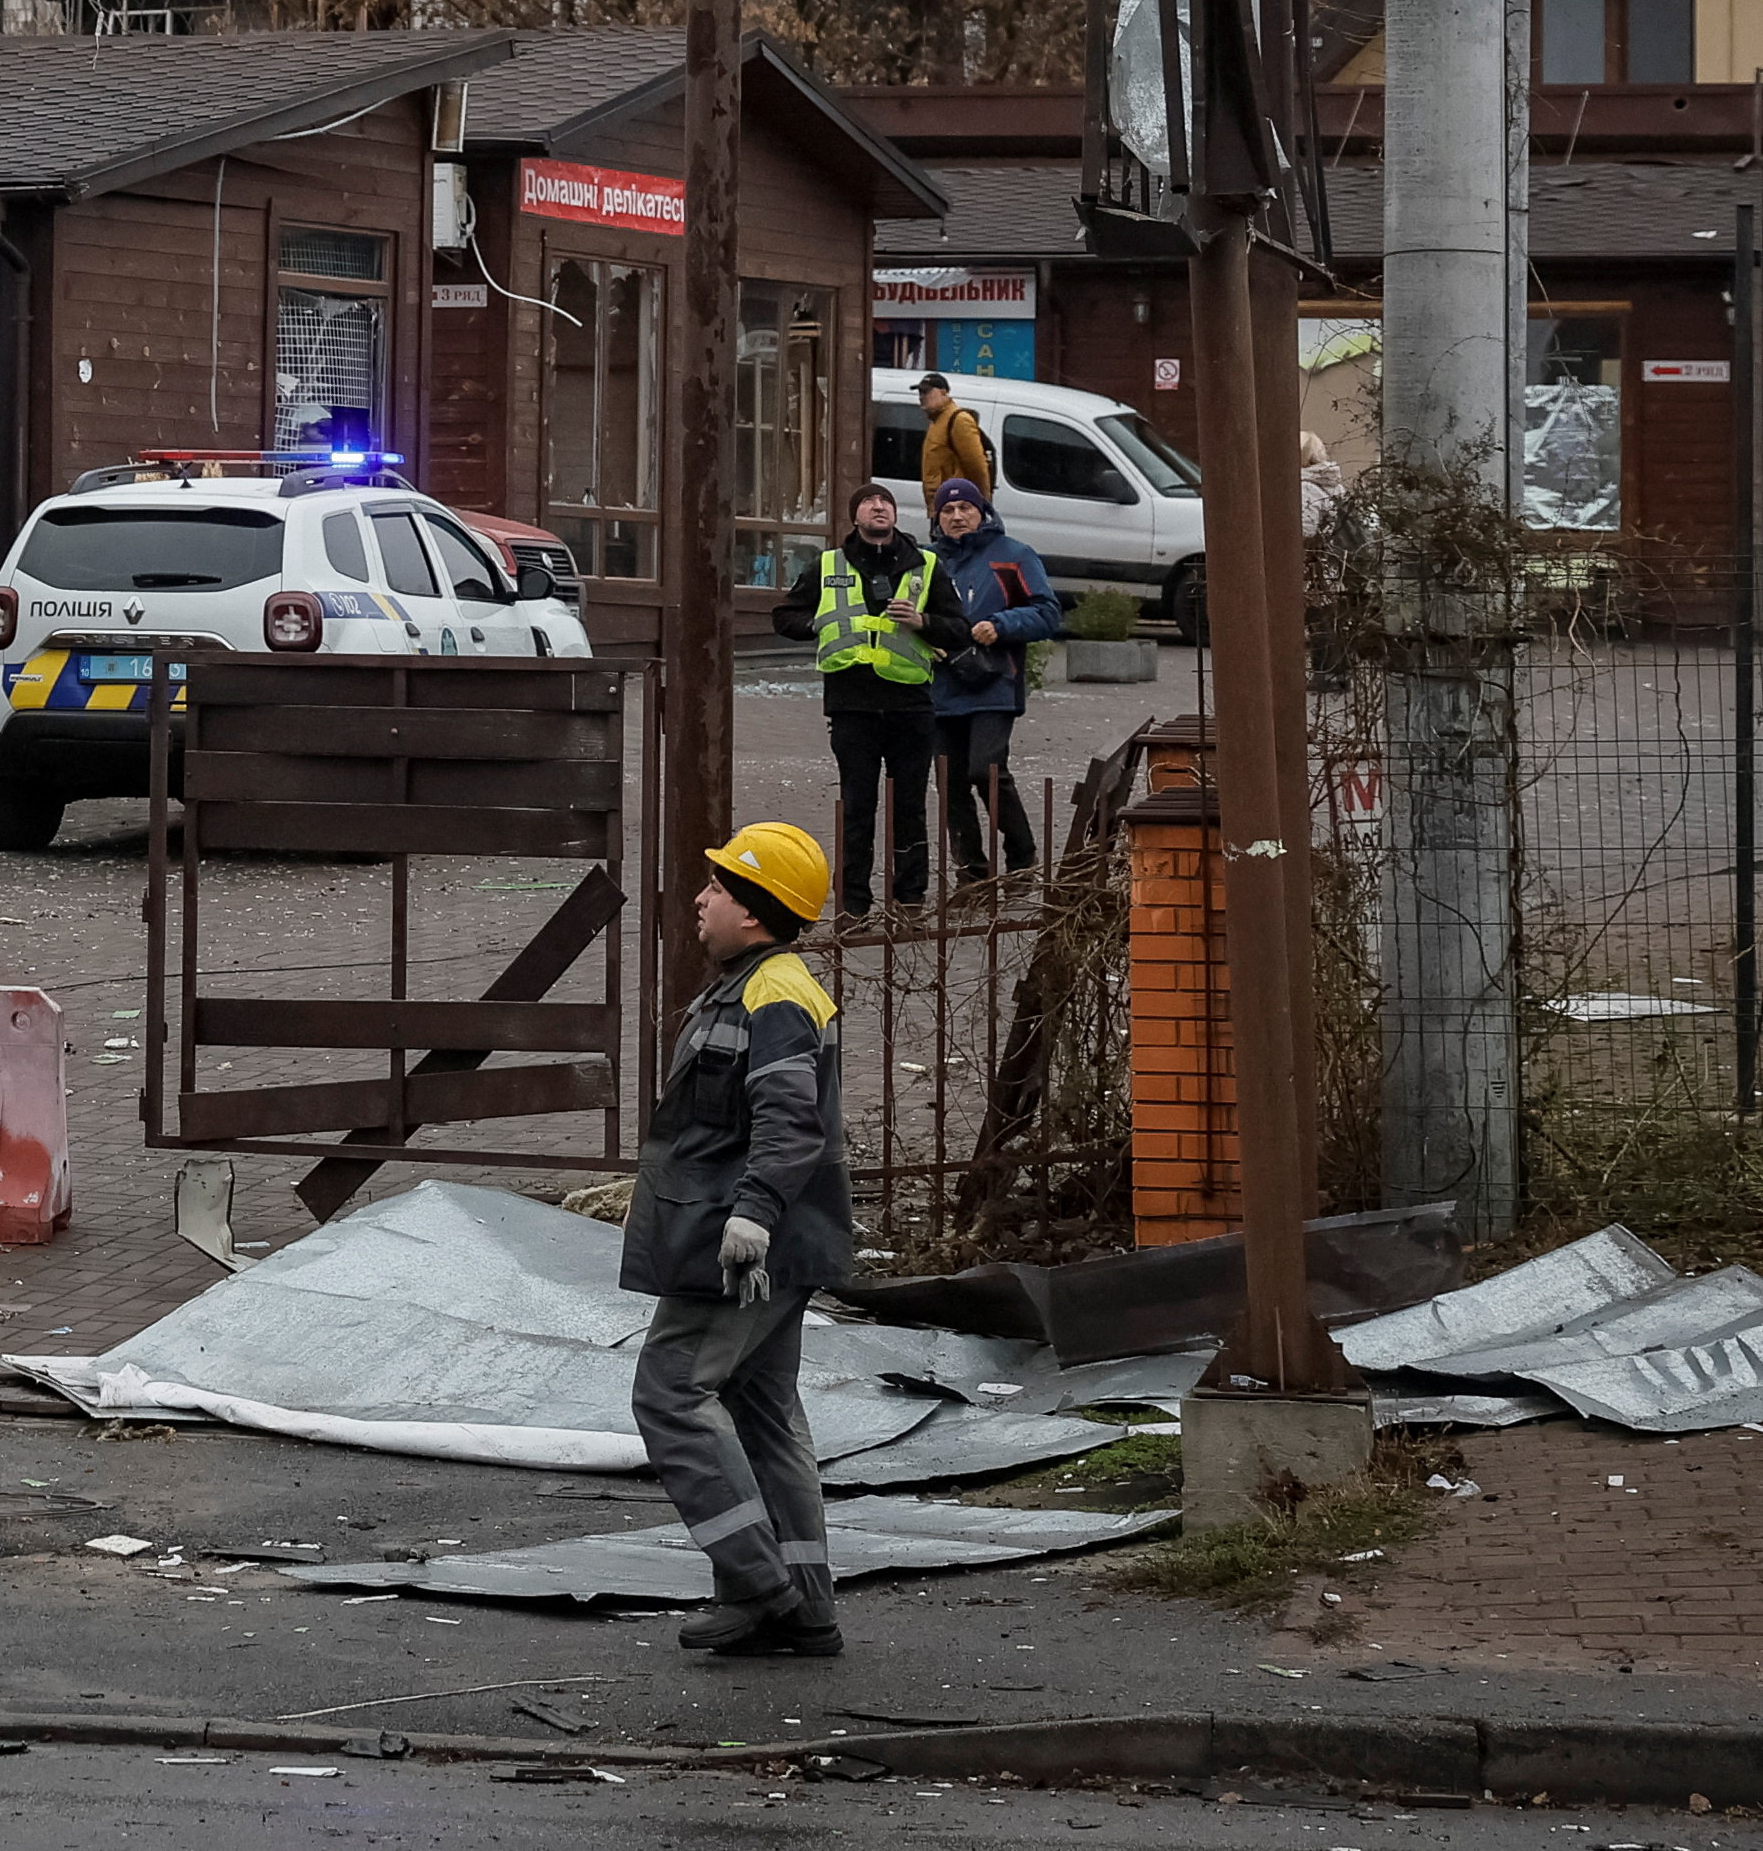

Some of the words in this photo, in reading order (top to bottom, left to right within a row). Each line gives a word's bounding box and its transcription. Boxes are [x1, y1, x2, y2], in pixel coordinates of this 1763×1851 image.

[524, 168, 599, 209] Домашні
[30, 601, 112, 617] ПОЛІЦІЯ
[341, 595, 362, 615] 102
